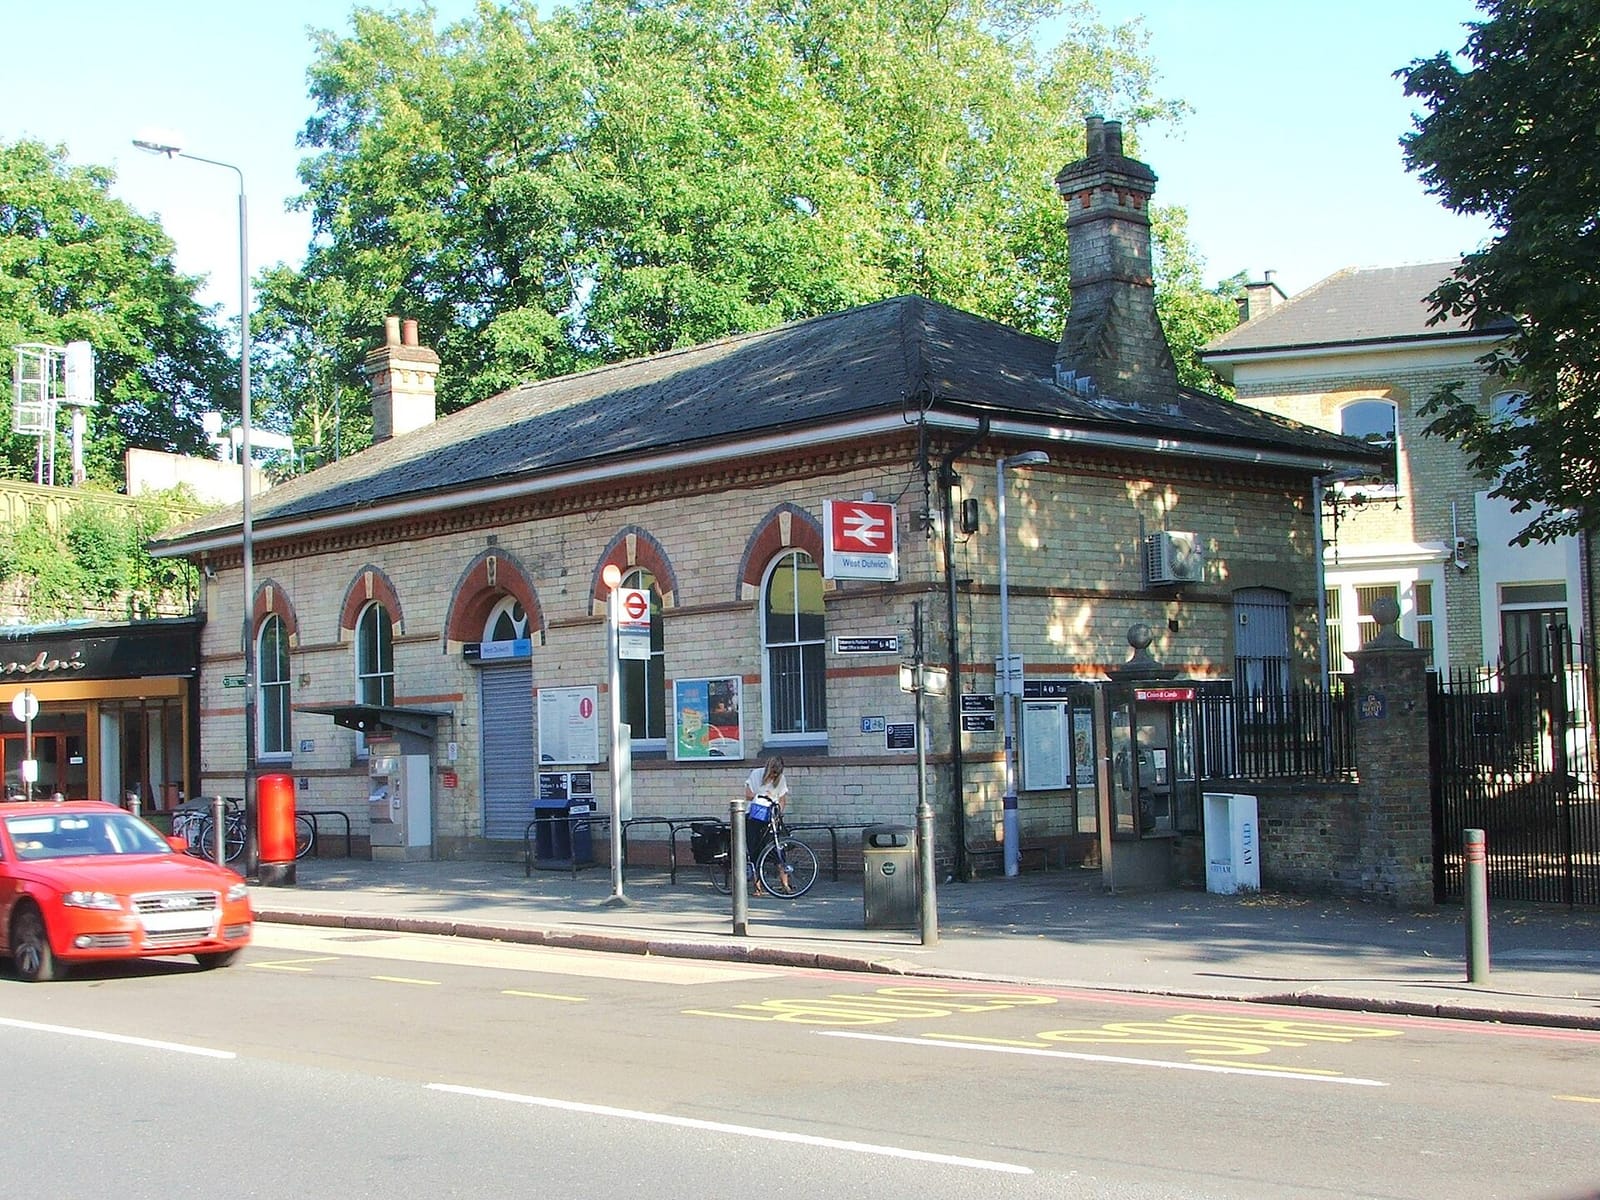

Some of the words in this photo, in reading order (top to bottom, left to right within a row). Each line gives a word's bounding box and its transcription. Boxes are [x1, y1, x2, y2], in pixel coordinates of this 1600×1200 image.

[843, 558, 861, 568] West
[862, 559, 889, 569] Dulwich
[863, 719, 871, 731] P
